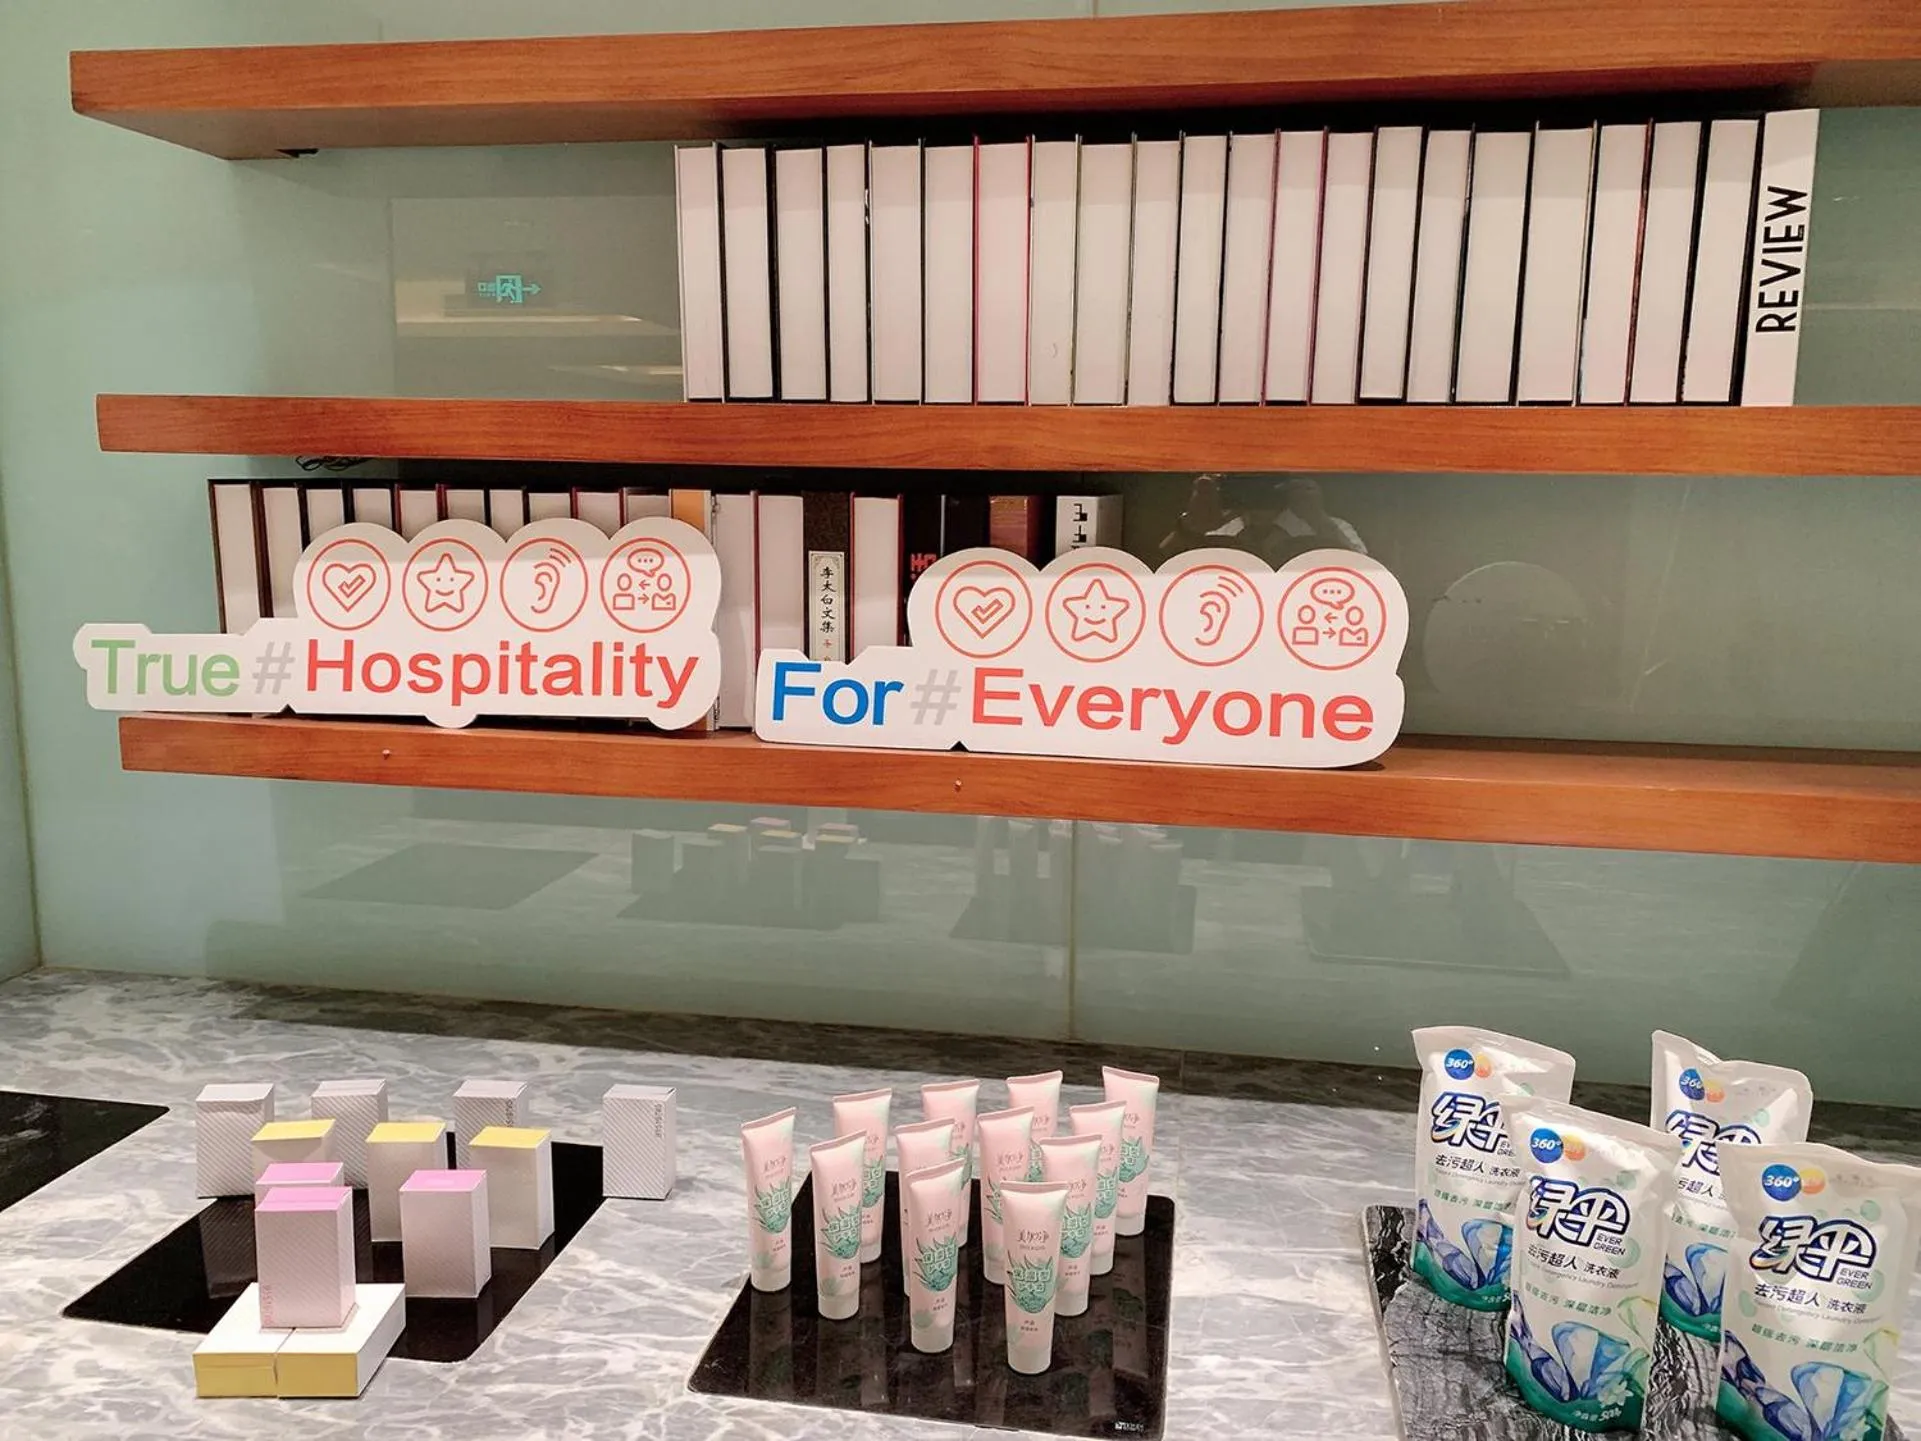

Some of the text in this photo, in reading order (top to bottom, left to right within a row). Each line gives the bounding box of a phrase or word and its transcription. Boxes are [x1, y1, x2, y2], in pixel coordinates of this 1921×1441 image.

[1755, 185, 1808, 333] REVIEW
[90, 639, 240, 697] True
[772, 661, 904, 726] For
[972, 667, 1374, 745] Everyone
[1435, 1154, 1485, 1174] 去污超人
[1526, 1174, 1631, 1248] 绿伞
[1593, 1242, 1626, 1256] GREEN
[1597, 1233, 1623, 1246] EVER
[1749, 1215, 1877, 1283] 绿伞
[1528, 1243, 1578, 1271] 去污超人
[1583, 1261, 1621, 1280] 洗衣液
[1839, 1267, 1870, 1280] EVER
[1753, 1283, 1821, 1308] 去污超人
[1826, 1298, 1868, 1315] 洗衣液
[1835, 1278, 1873, 1290] GREEN
